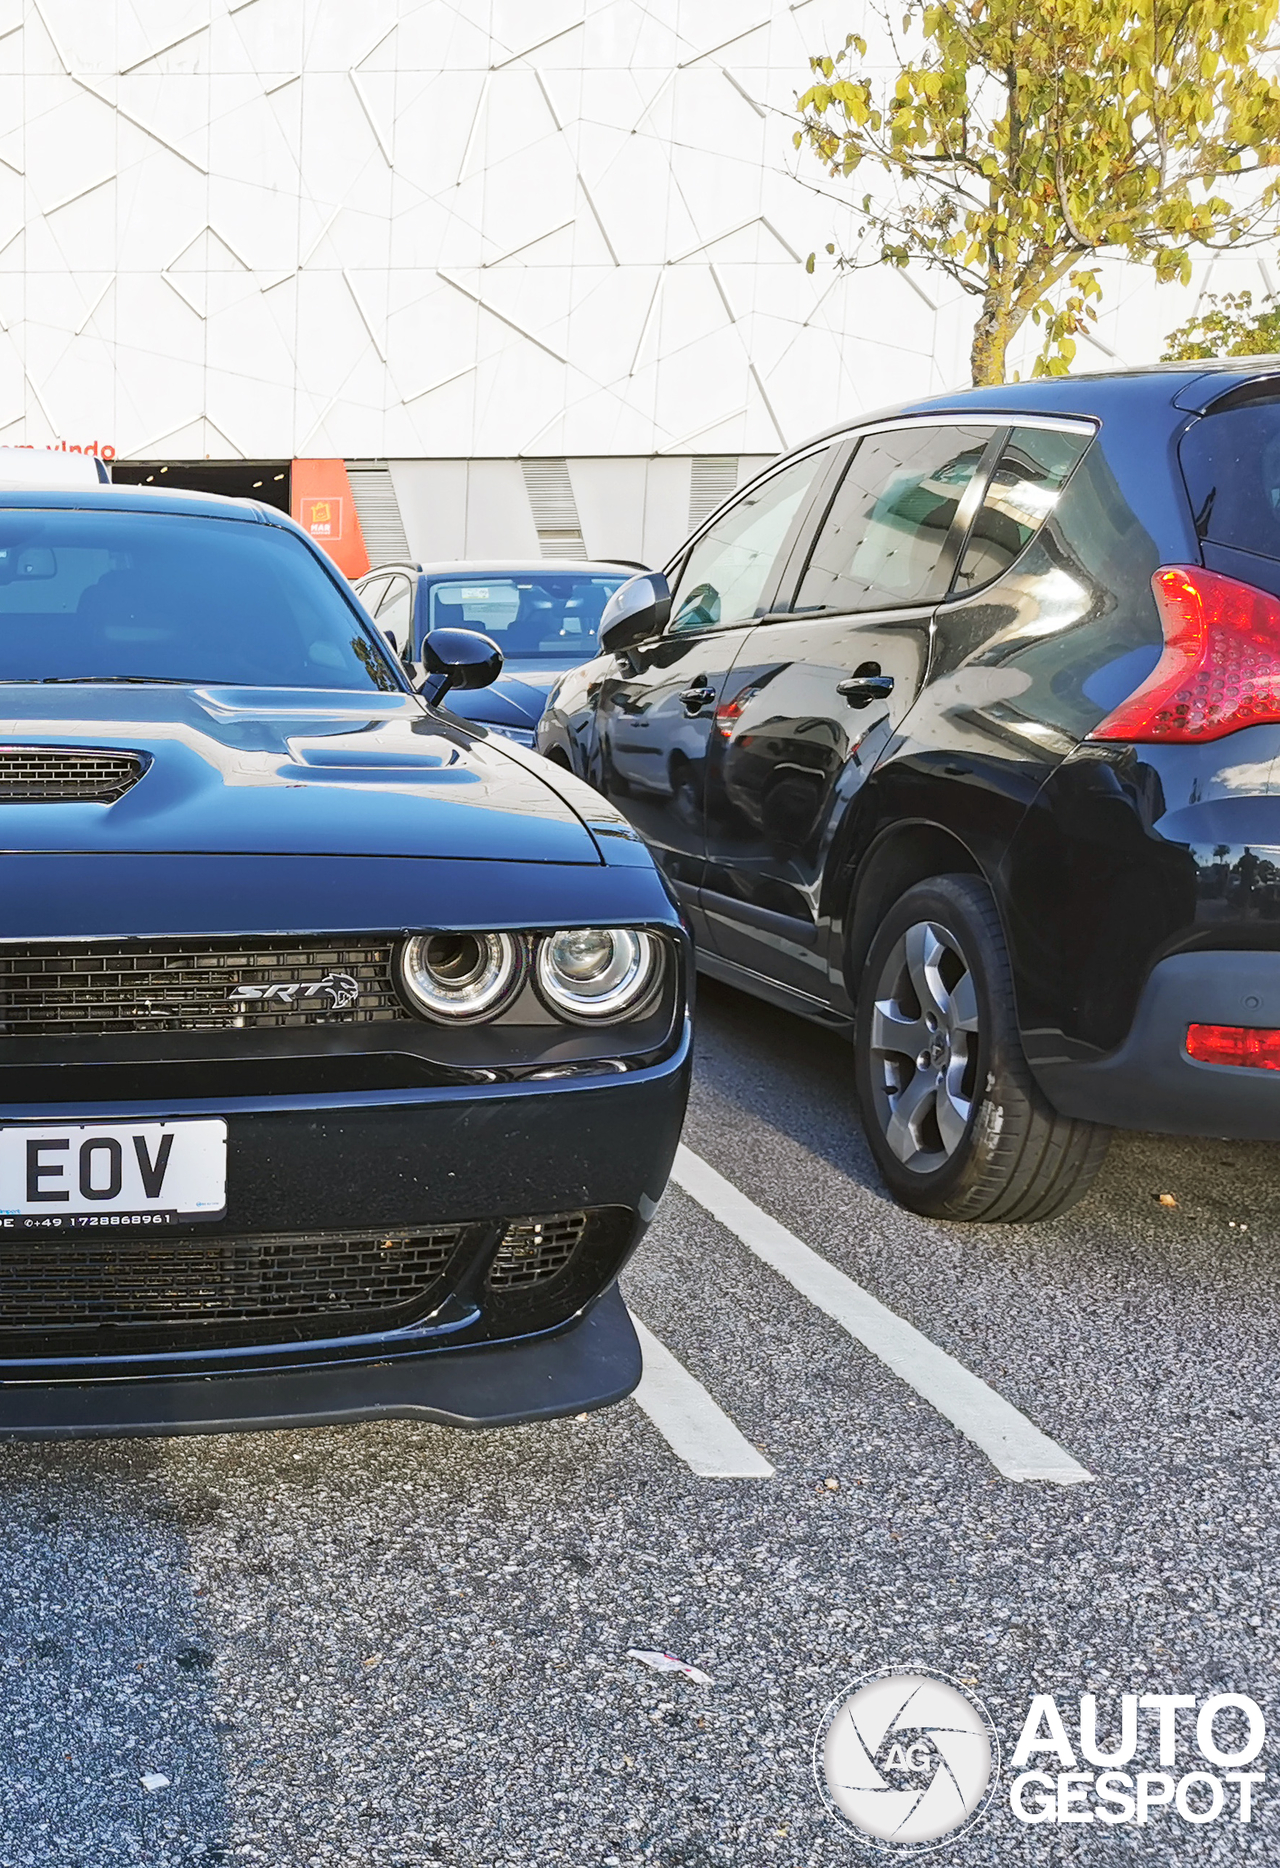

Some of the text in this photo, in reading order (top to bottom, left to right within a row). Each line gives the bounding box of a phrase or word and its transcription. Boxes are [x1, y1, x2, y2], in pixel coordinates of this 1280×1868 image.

[228, 981, 334, 1003] SRT
[26, 1134, 175, 1202] EOV
[70, 1214, 171, 1227] 1728868961
